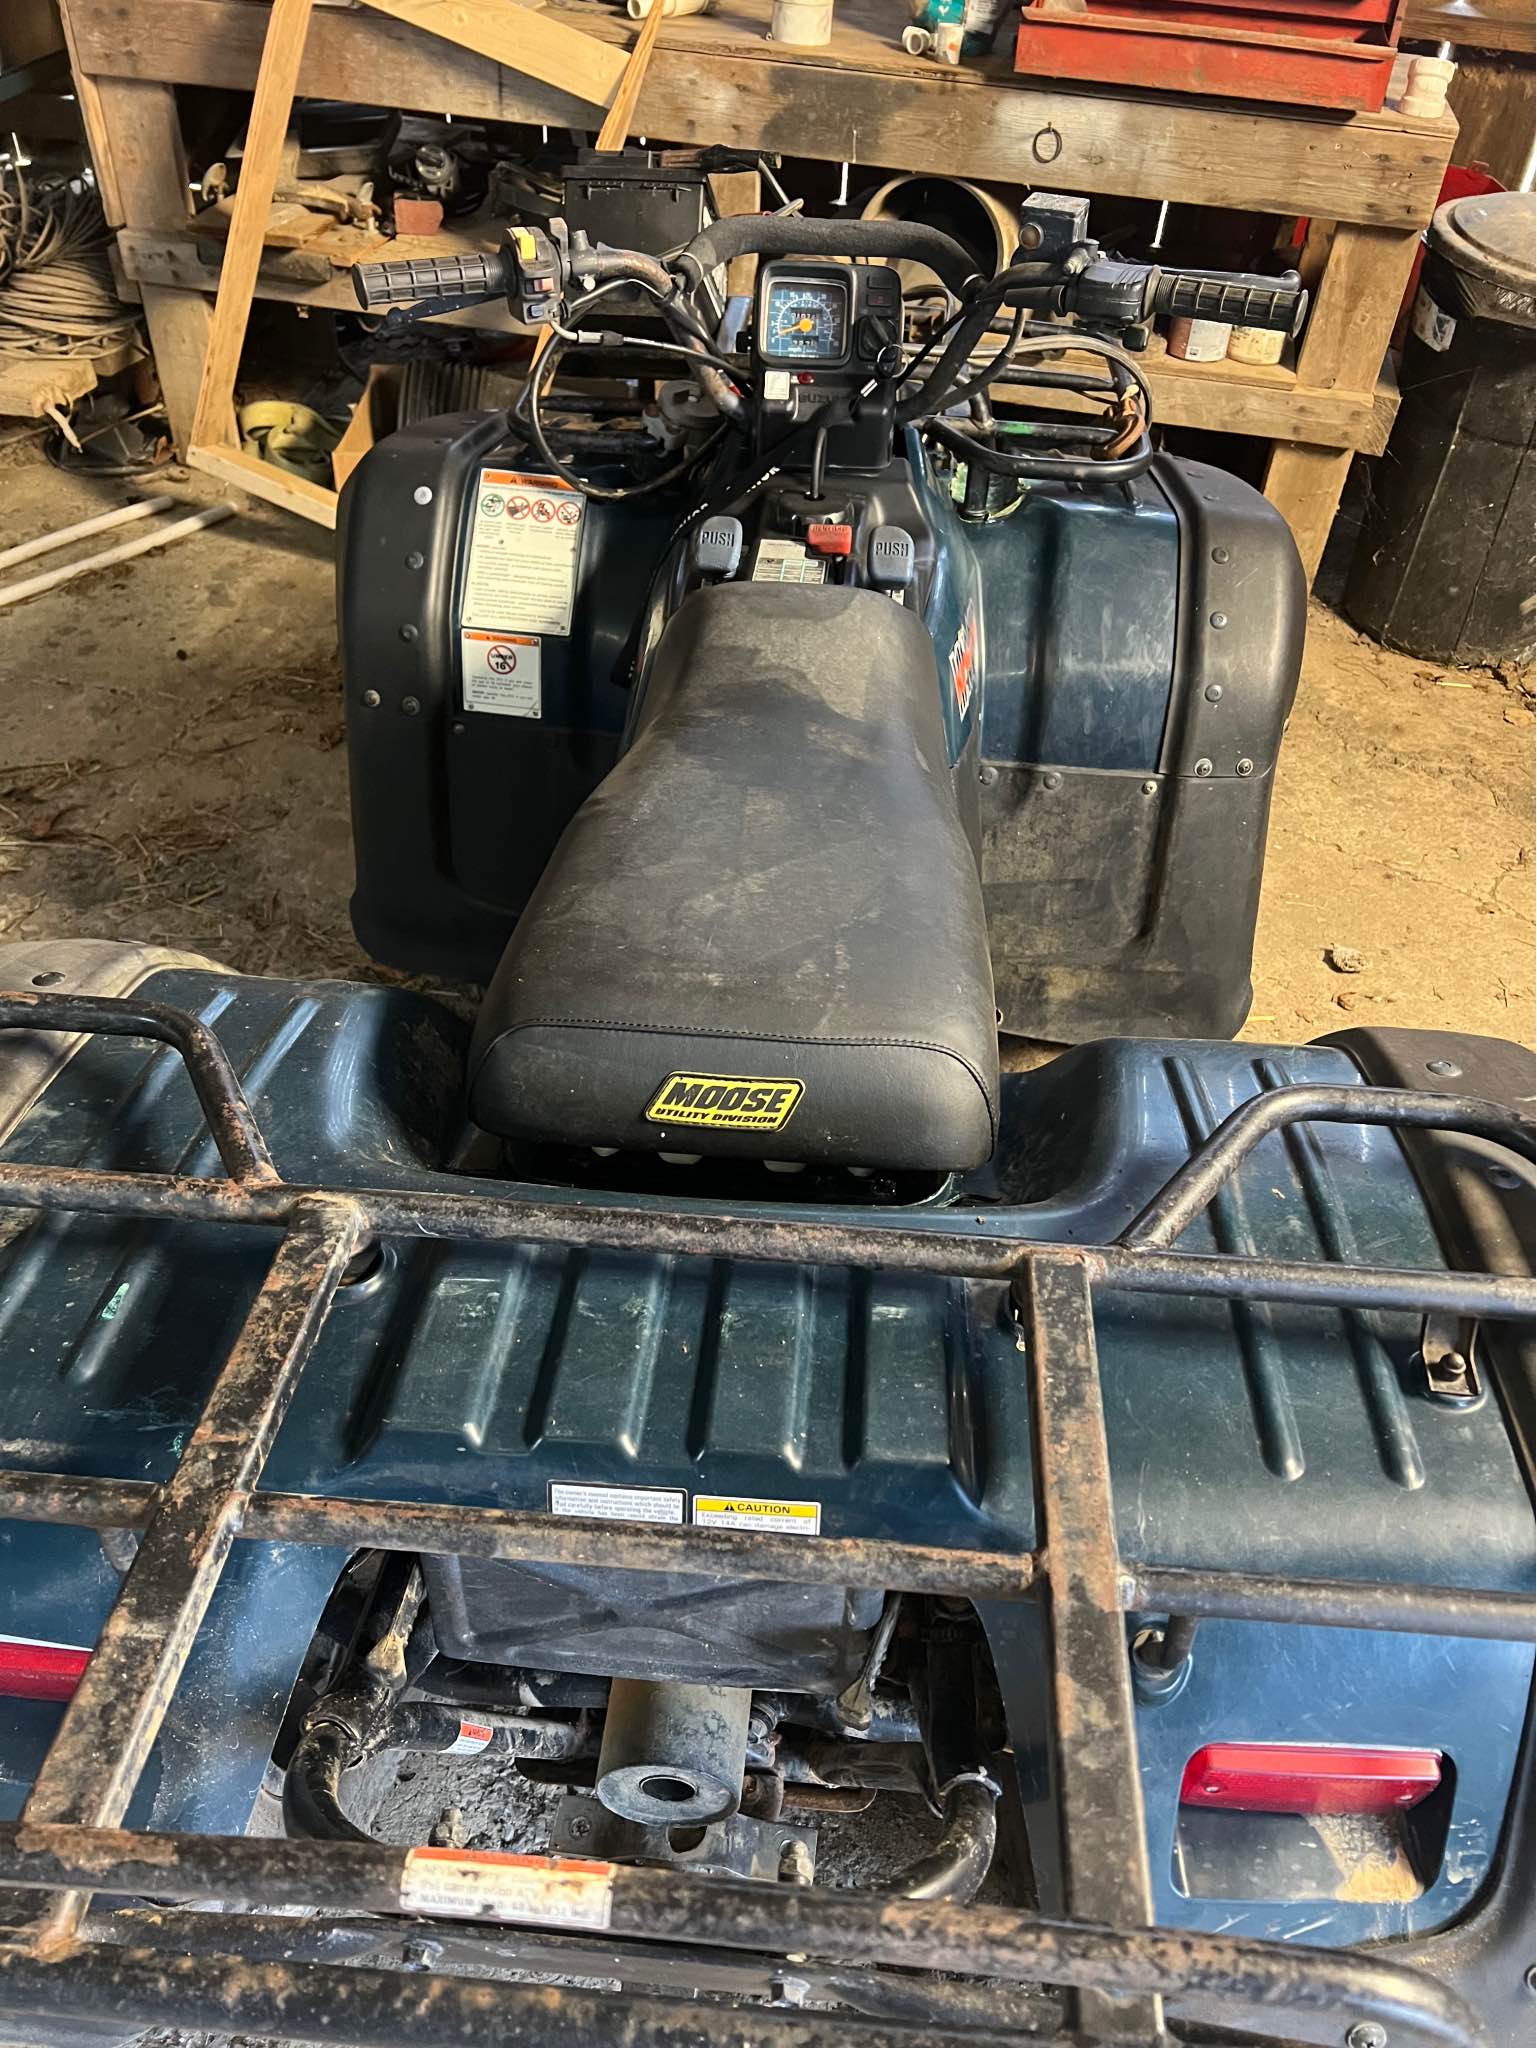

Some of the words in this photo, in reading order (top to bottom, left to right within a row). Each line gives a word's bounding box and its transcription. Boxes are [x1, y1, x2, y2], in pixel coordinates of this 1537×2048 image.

[702, 530, 735, 547] PUSH
[875, 541, 909, 557] PUSH
[495, 661, 507, 670] 16
[661, 1081, 793, 1113] MOOSE
[655, 1107, 710, 1120] UTILITY
[711, 1113, 778, 1124] DIVISION
[701, 1512, 738, 1521] Exceeding
[737, 1503, 791, 1514] CAUTION
